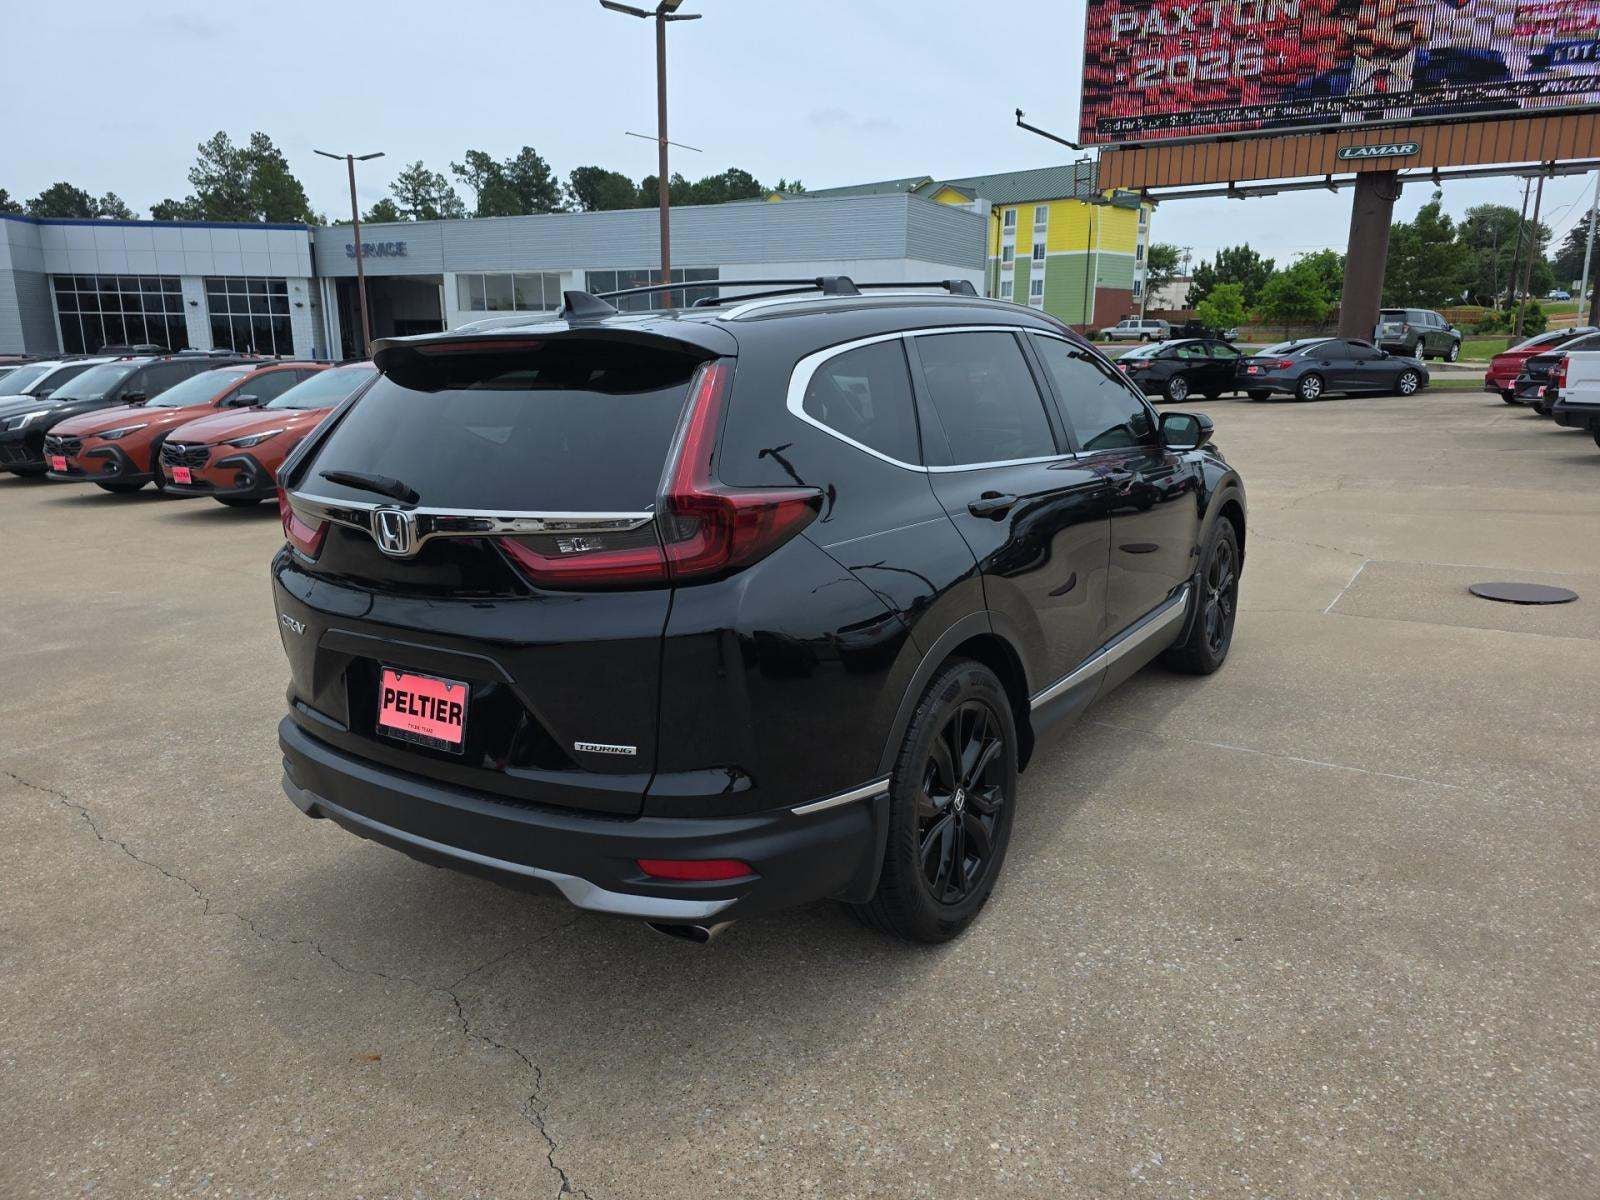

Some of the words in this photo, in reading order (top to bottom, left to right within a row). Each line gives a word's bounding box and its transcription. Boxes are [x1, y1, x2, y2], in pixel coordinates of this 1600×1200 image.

[1110, 0, 1301, 42] PAXTON
[1135, 47, 1264, 88] 2026
[1344, 144, 1413, 157] LAMAR
[383, 687, 462, 726] PELTIER
[578, 744, 632, 754] TOURING
